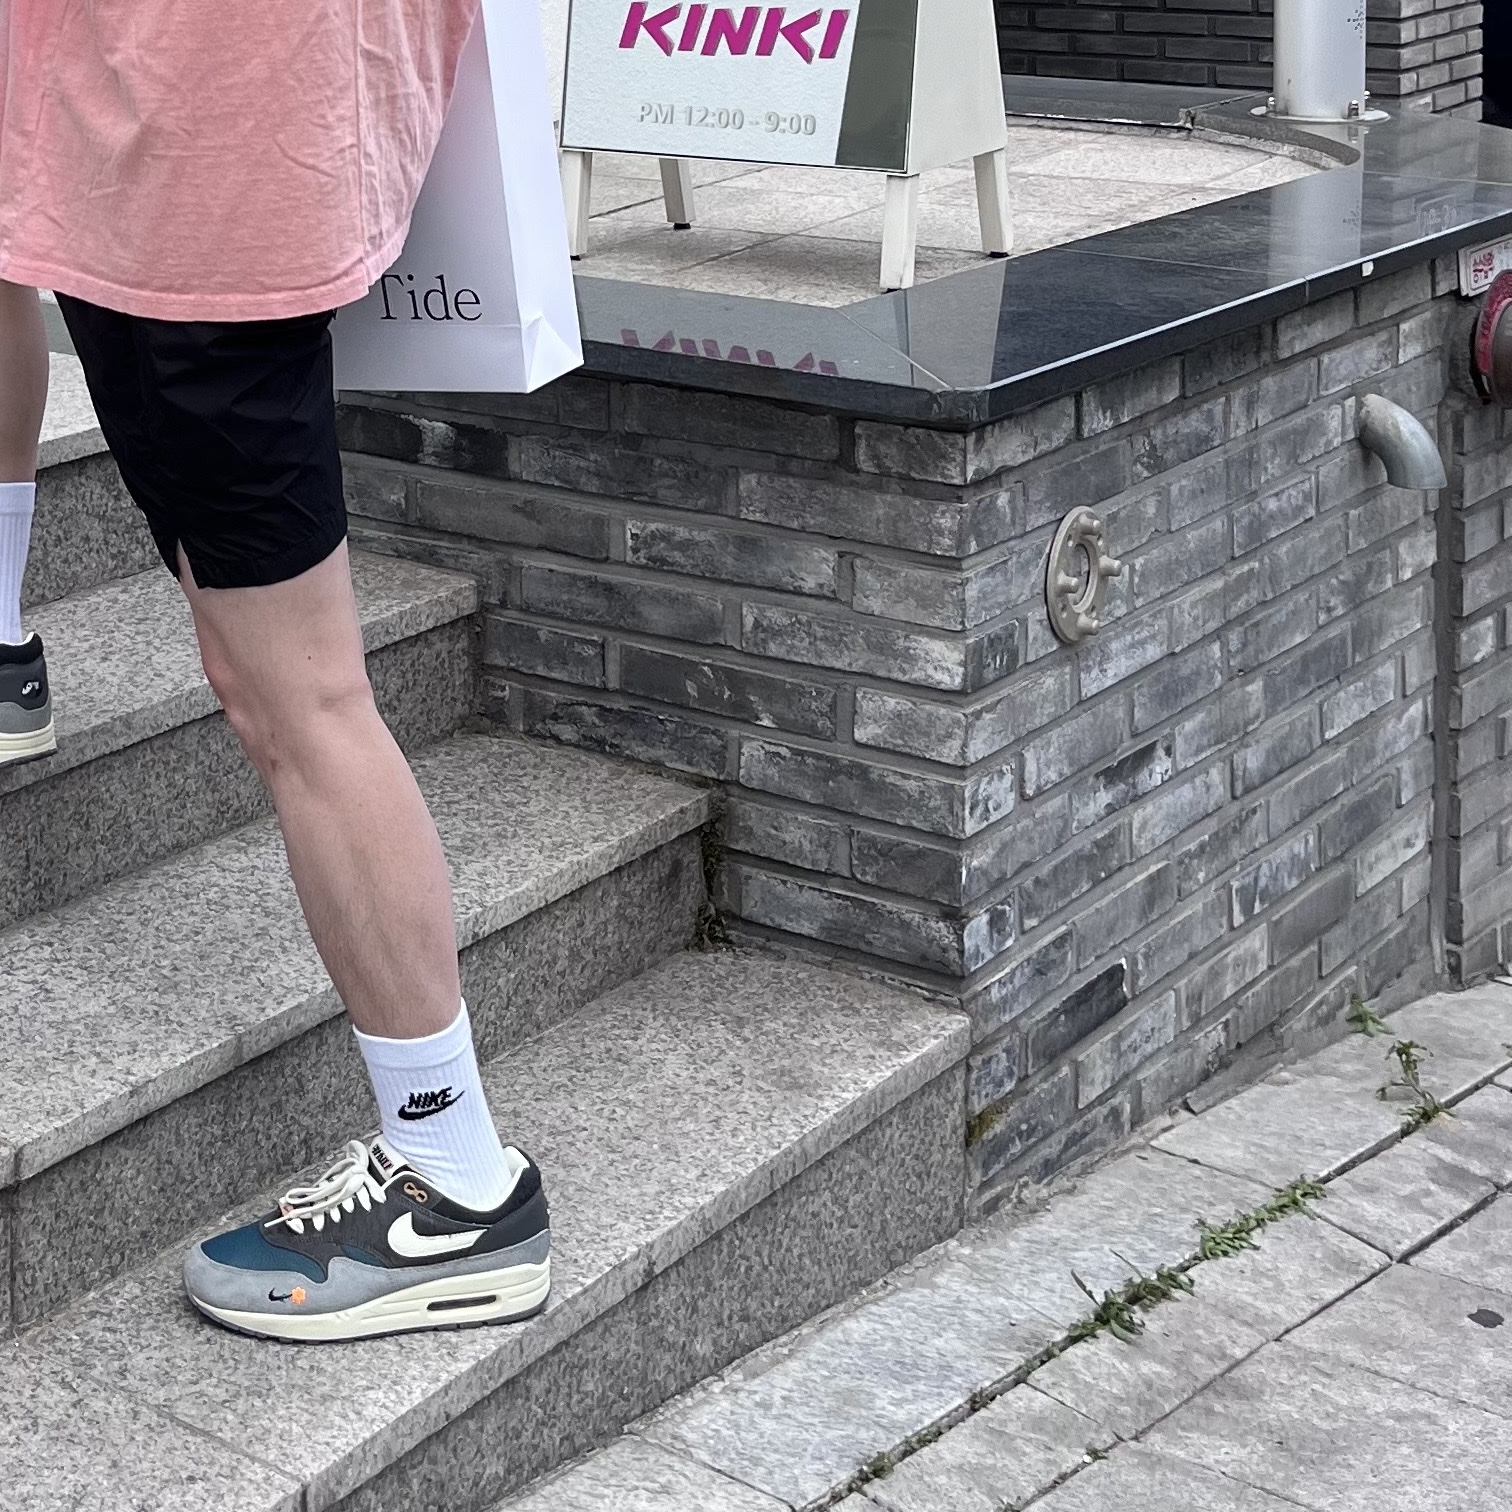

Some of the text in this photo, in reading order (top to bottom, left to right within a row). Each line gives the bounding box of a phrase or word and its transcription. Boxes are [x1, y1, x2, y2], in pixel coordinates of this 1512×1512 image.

[618, 1, 852, 65] KINKI
[637, 102, 675, 126] PM
[682, 105, 745, 131] 12:00
[764, 111, 818, 136] 9:00
[380, 274, 483, 321] Tide
